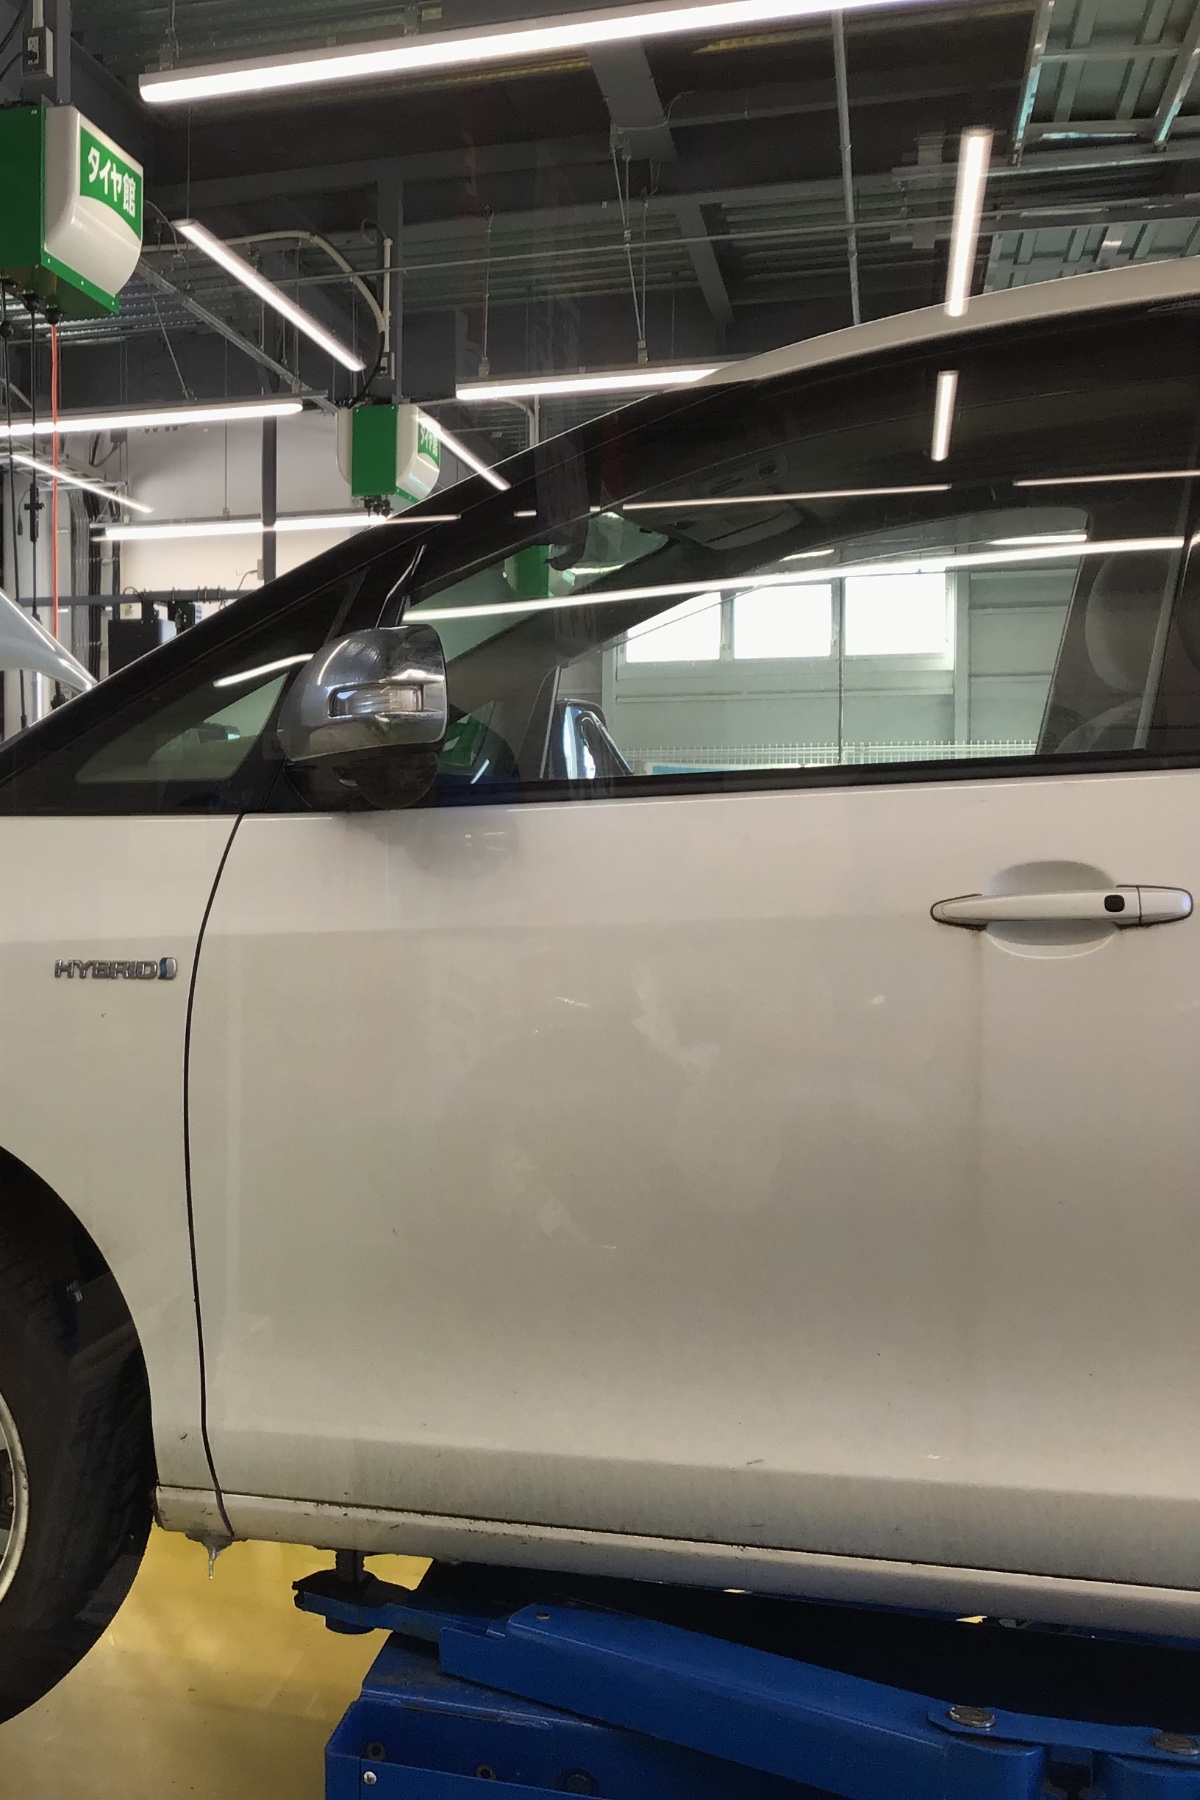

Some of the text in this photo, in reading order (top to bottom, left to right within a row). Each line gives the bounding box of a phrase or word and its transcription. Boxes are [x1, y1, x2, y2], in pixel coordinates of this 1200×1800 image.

[87, 145, 136, 218] タイヤ館
[54, 959, 159, 980] HYBRID
